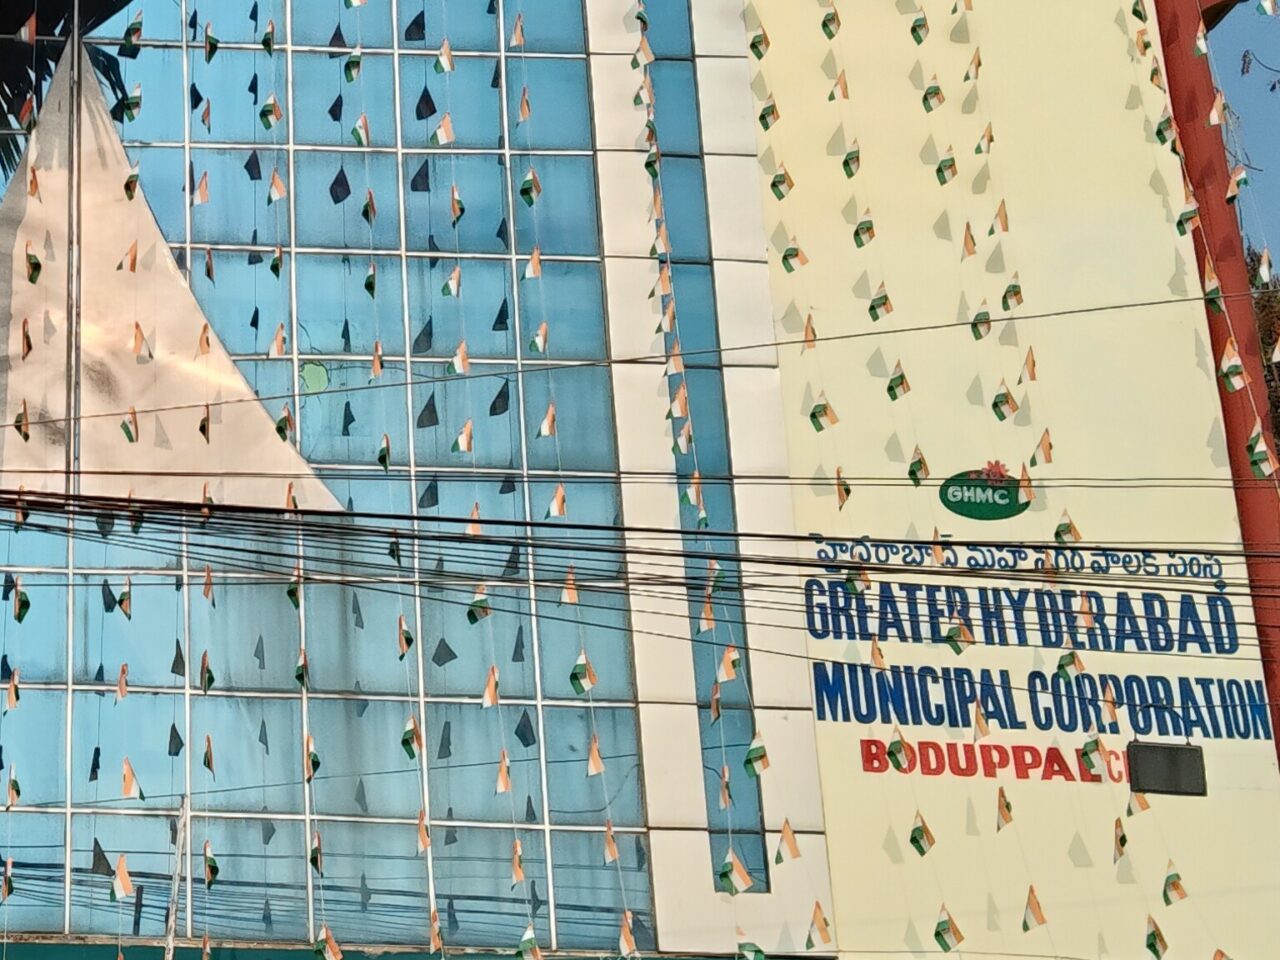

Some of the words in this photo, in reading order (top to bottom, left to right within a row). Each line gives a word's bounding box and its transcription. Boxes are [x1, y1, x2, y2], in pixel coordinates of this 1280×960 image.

[946, 485, 1010, 506] GHMC
[803, 578, 975, 644] GREATER
[977, 586, 1240, 655] HYDERABAD
[812, 661, 1027, 730] MUNICIPAL
[1027, 670, 1273, 741] CORPORATION
[860, 738, 1103, 784] BODUPPAL
